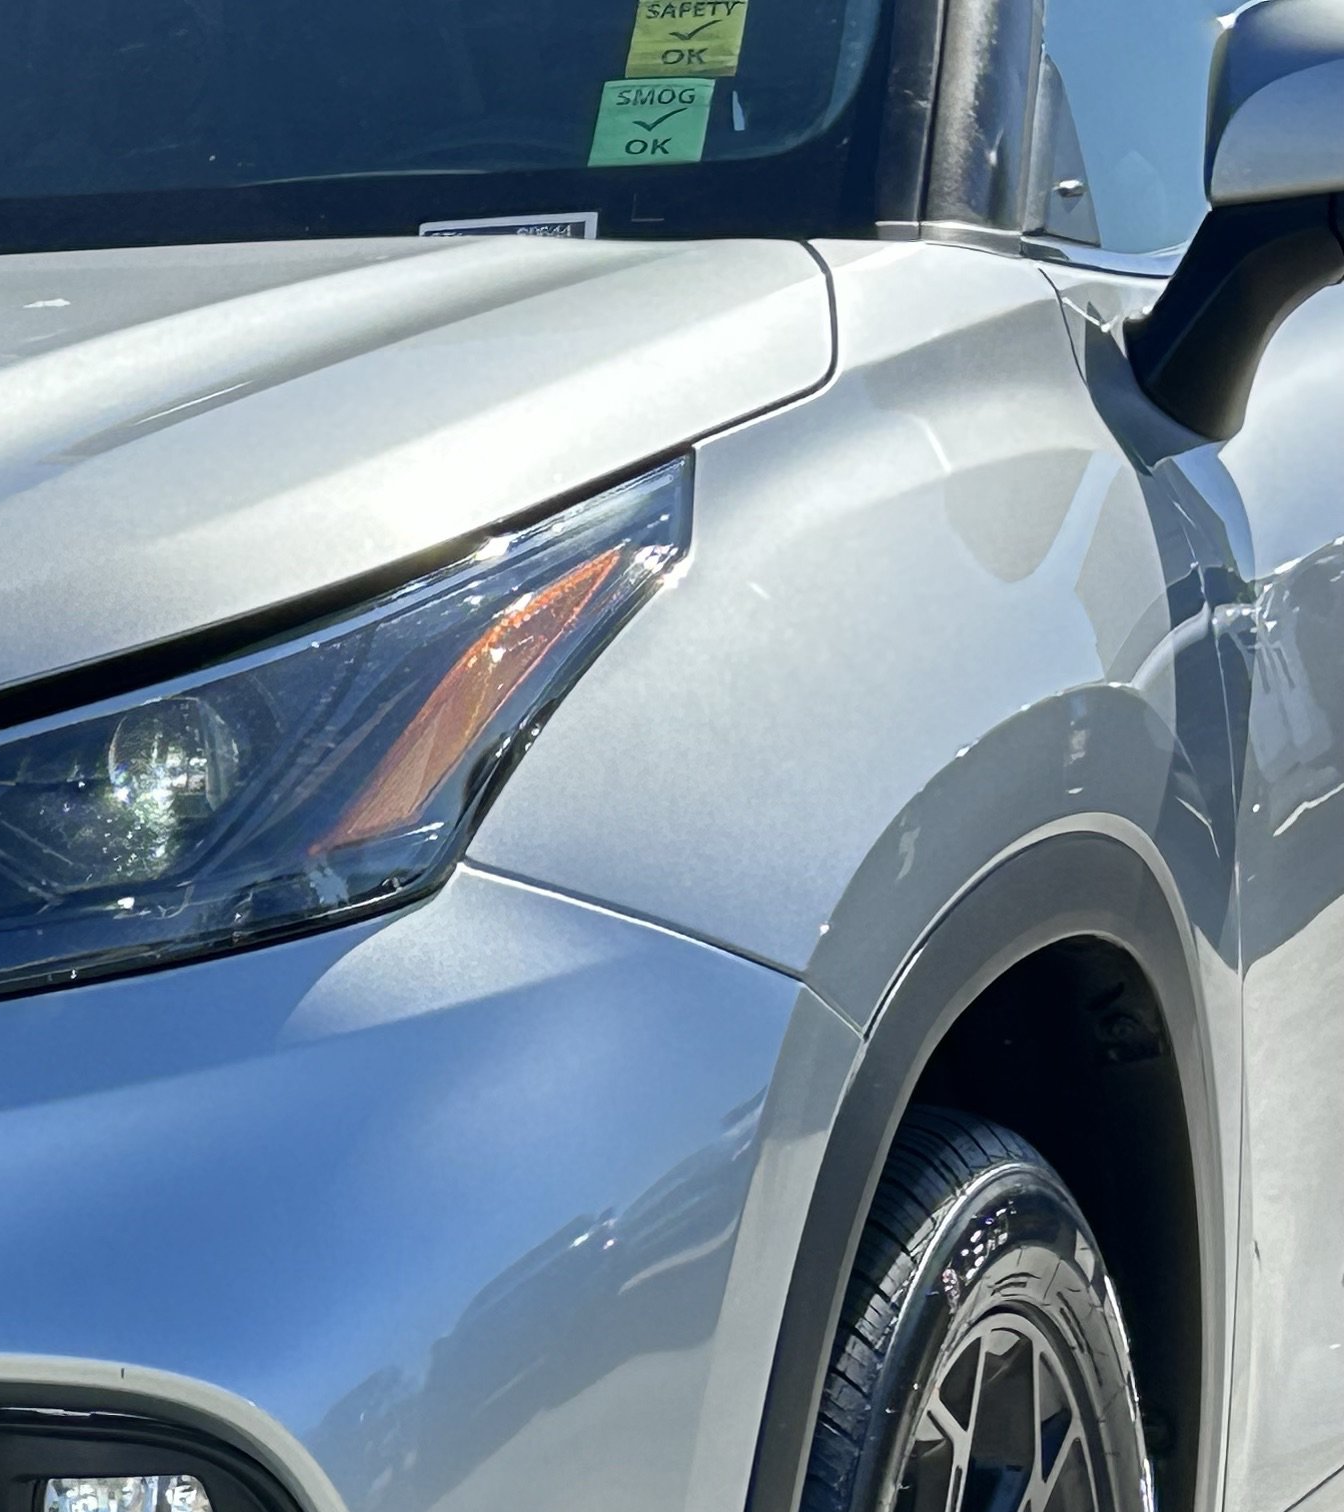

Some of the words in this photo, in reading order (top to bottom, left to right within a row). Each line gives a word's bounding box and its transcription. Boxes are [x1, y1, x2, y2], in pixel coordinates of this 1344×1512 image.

[645, 0, 745, 19] SAFETY
[661, 48, 708, 65] OK
[615, 87, 696, 106] SMOG
[624, 138, 672, 156] OK
